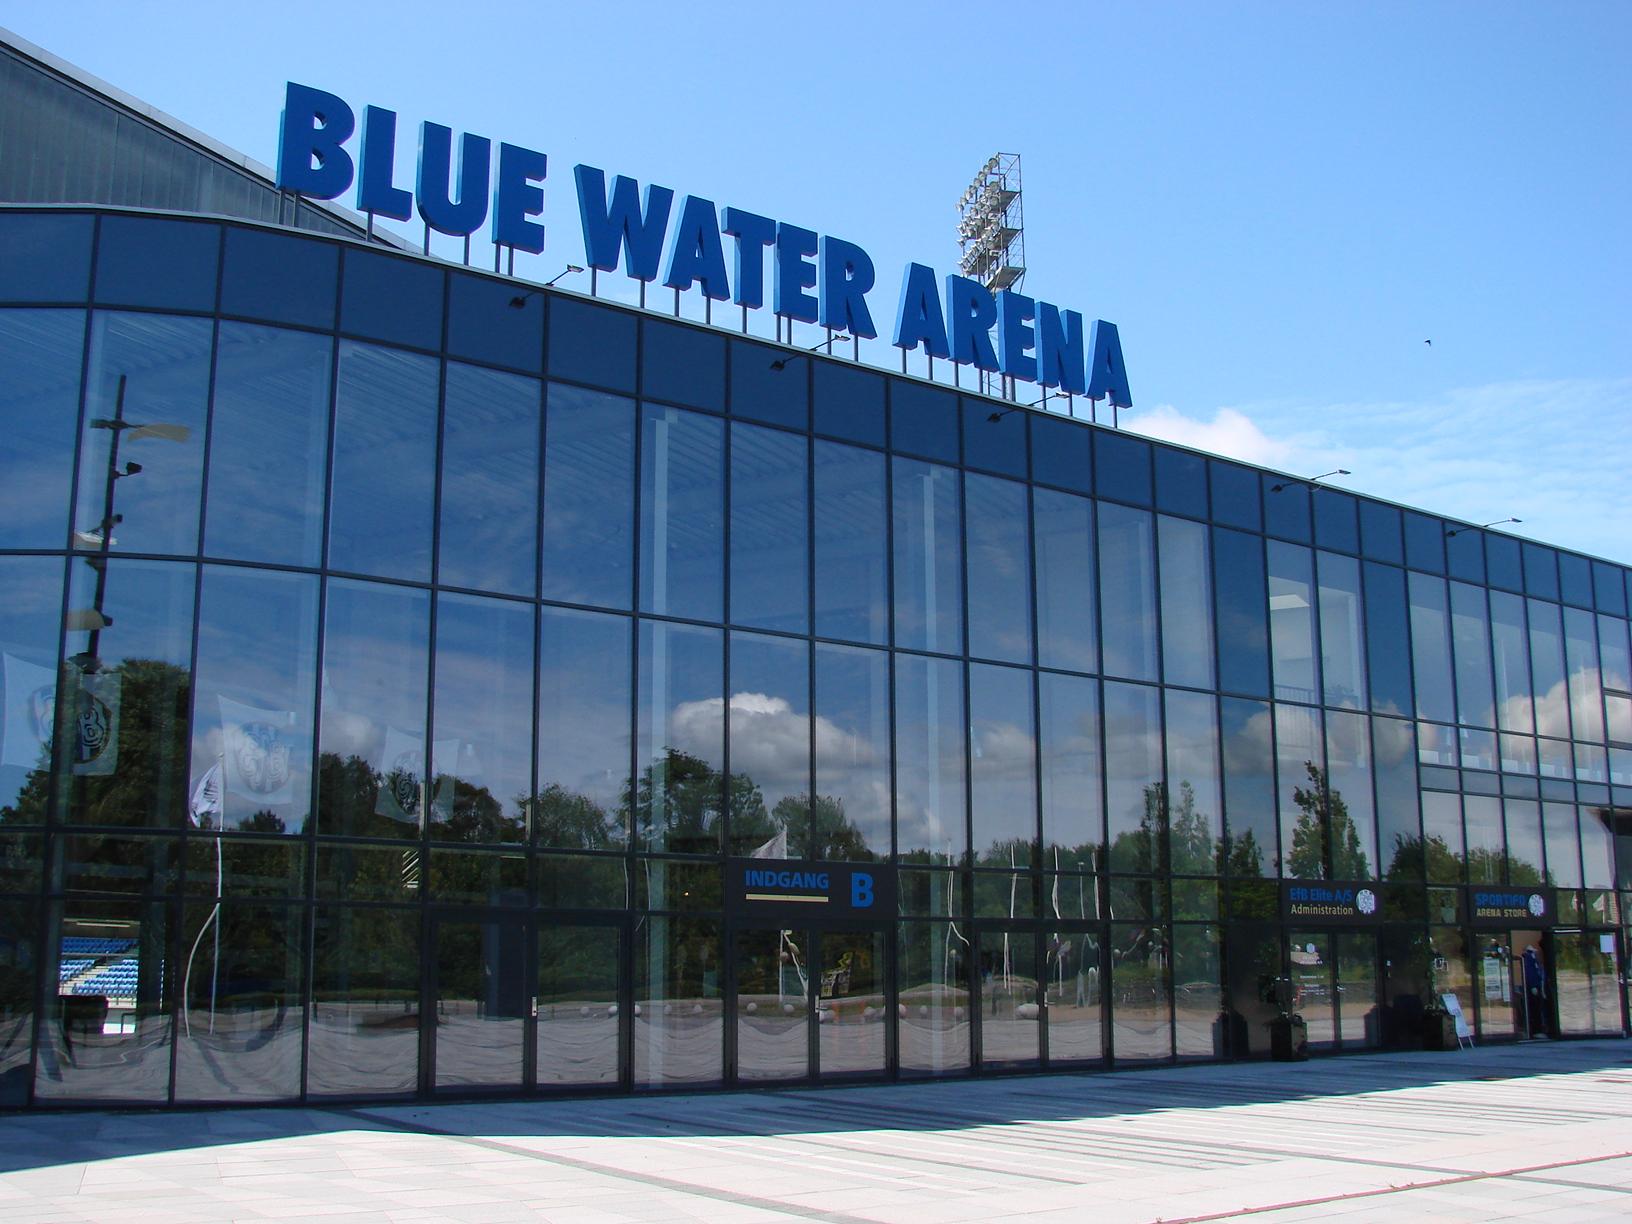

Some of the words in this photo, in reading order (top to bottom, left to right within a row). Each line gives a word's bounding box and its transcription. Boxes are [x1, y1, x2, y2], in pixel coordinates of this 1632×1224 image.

[275, 81, 547, 255] BLUE
[574, 163, 878, 339] WATER
[892, 262, 1133, 408] ARENA
[745, 870, 829, 889] INDGANG
[851, 871, 874, 908] B
[1310, 888, 1333, 901] Elite
[1334, 888, 1353, 903] A/S
[1290, 904, 1353, 915] Administration
[1476, 908, 1502, 917] ARENA
[1503, 908, 1527, 918] STORE
